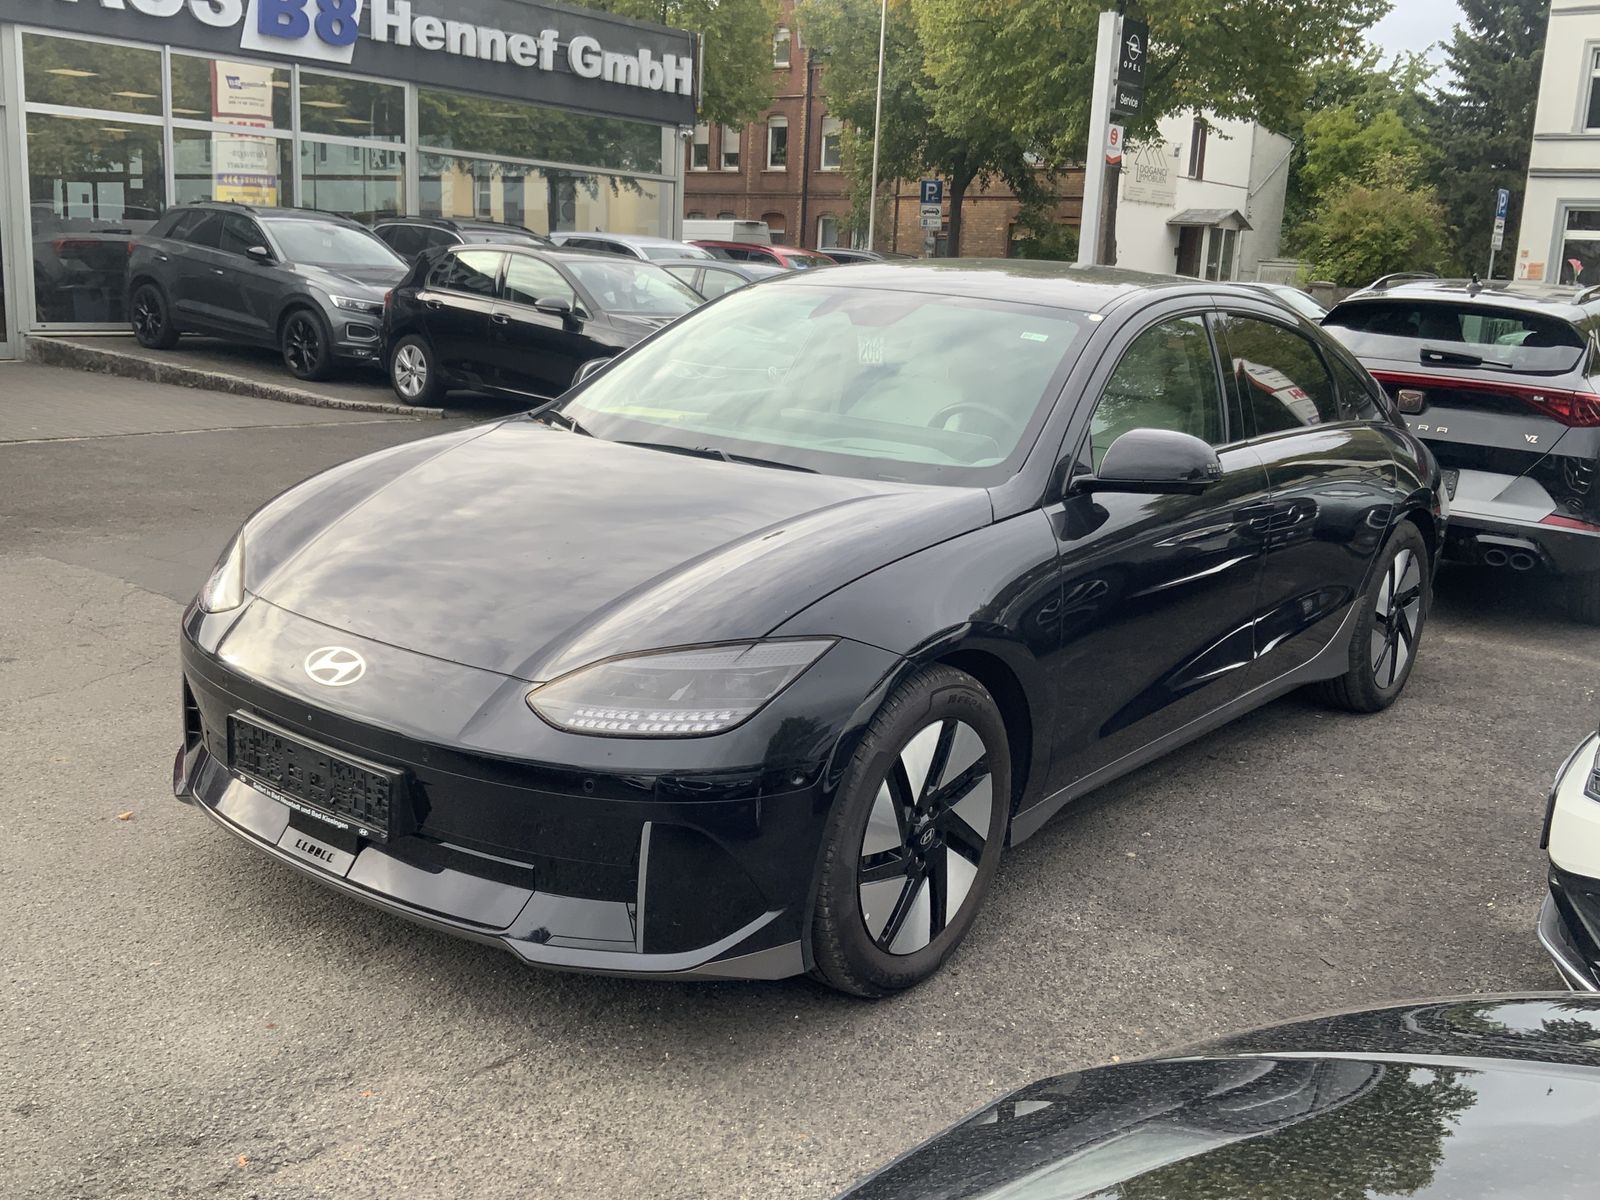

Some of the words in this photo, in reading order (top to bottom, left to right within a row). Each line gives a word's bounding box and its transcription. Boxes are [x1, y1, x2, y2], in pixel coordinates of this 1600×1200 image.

[371, 0, 559, 71] Hennef
[567, 35, 693, 96] GmbH
[1123, 60, 1141, 73] OPEL
[1119, 93, 1139, 109] Service
[925, 183, 938, 201] P
[1499, 193, 1507, 214] P
